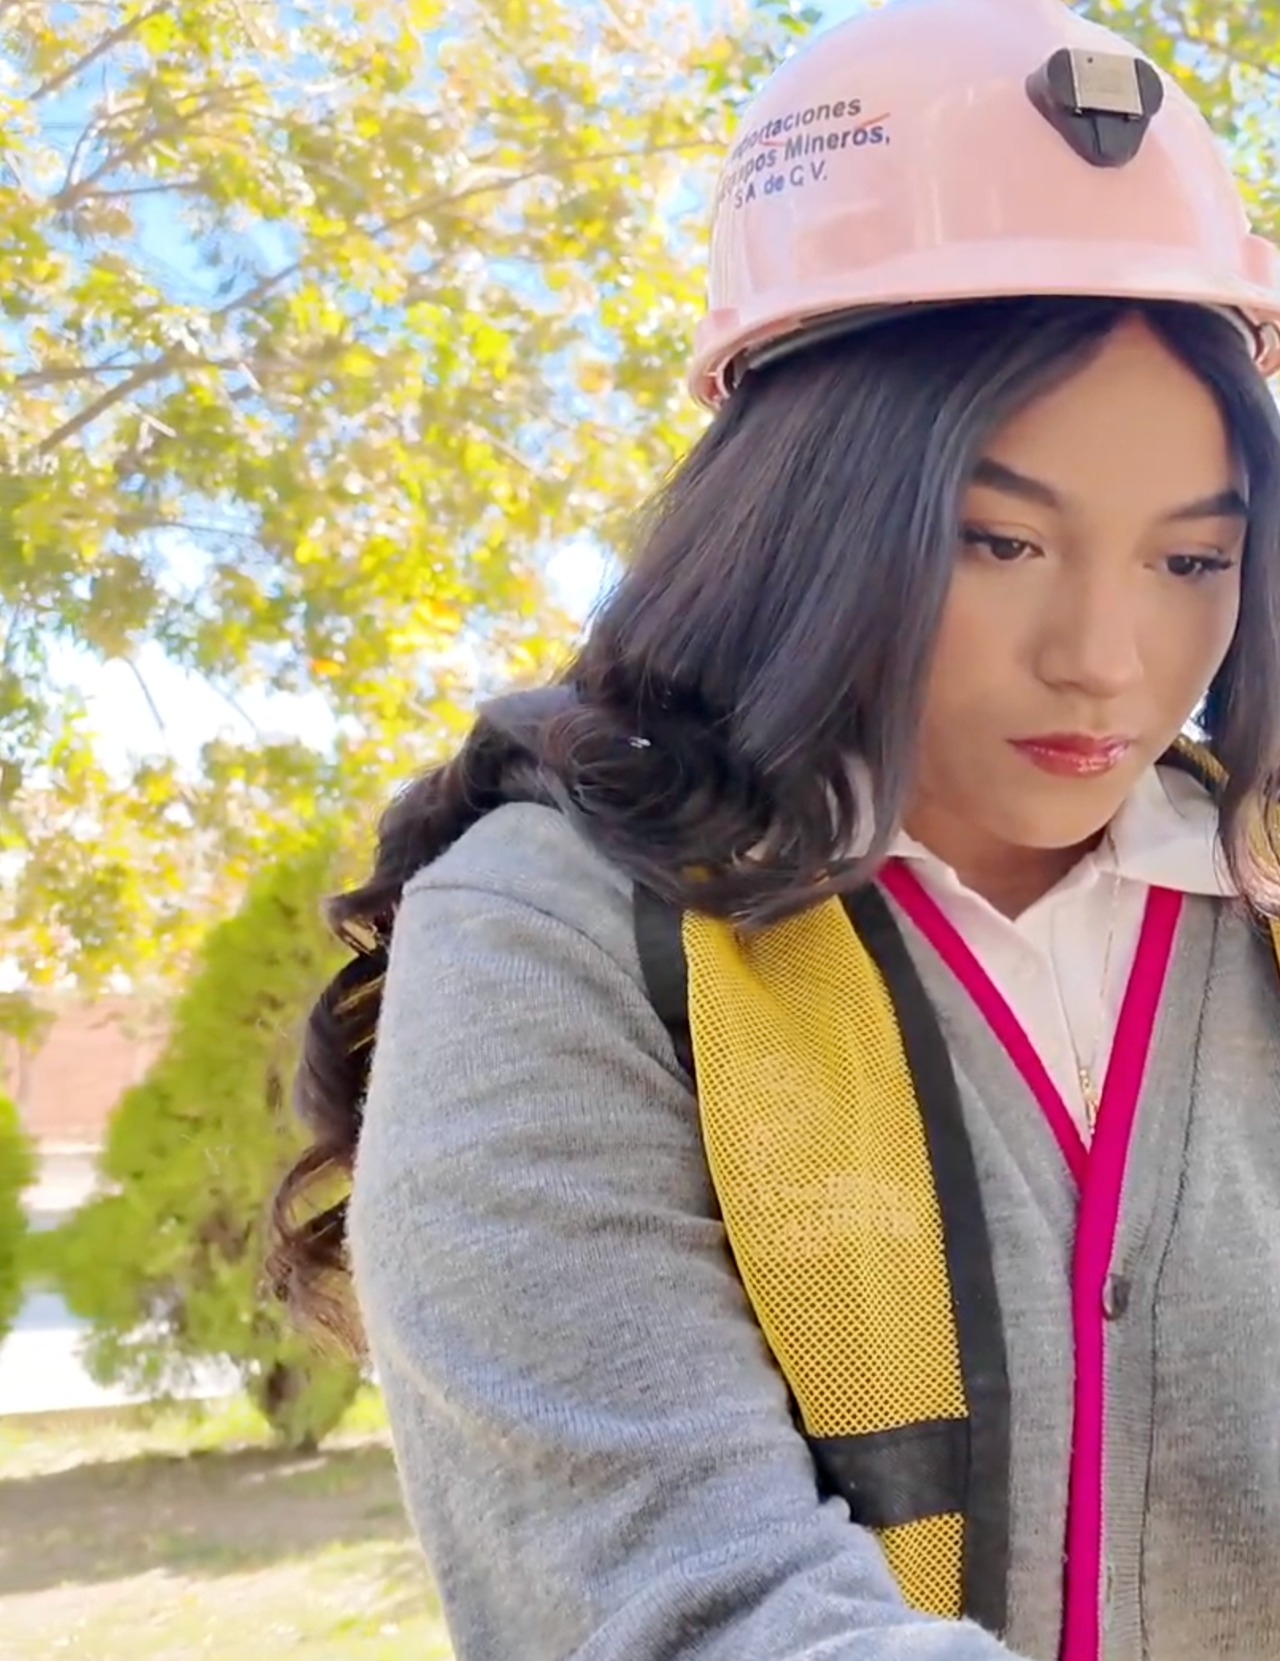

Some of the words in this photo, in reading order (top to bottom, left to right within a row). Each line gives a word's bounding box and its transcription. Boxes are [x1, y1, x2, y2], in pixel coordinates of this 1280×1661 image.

[731, 98, 862, 160] portaciones
[784, 125, 890, 161] Mineros,
[763, 172, 785, 195] de
